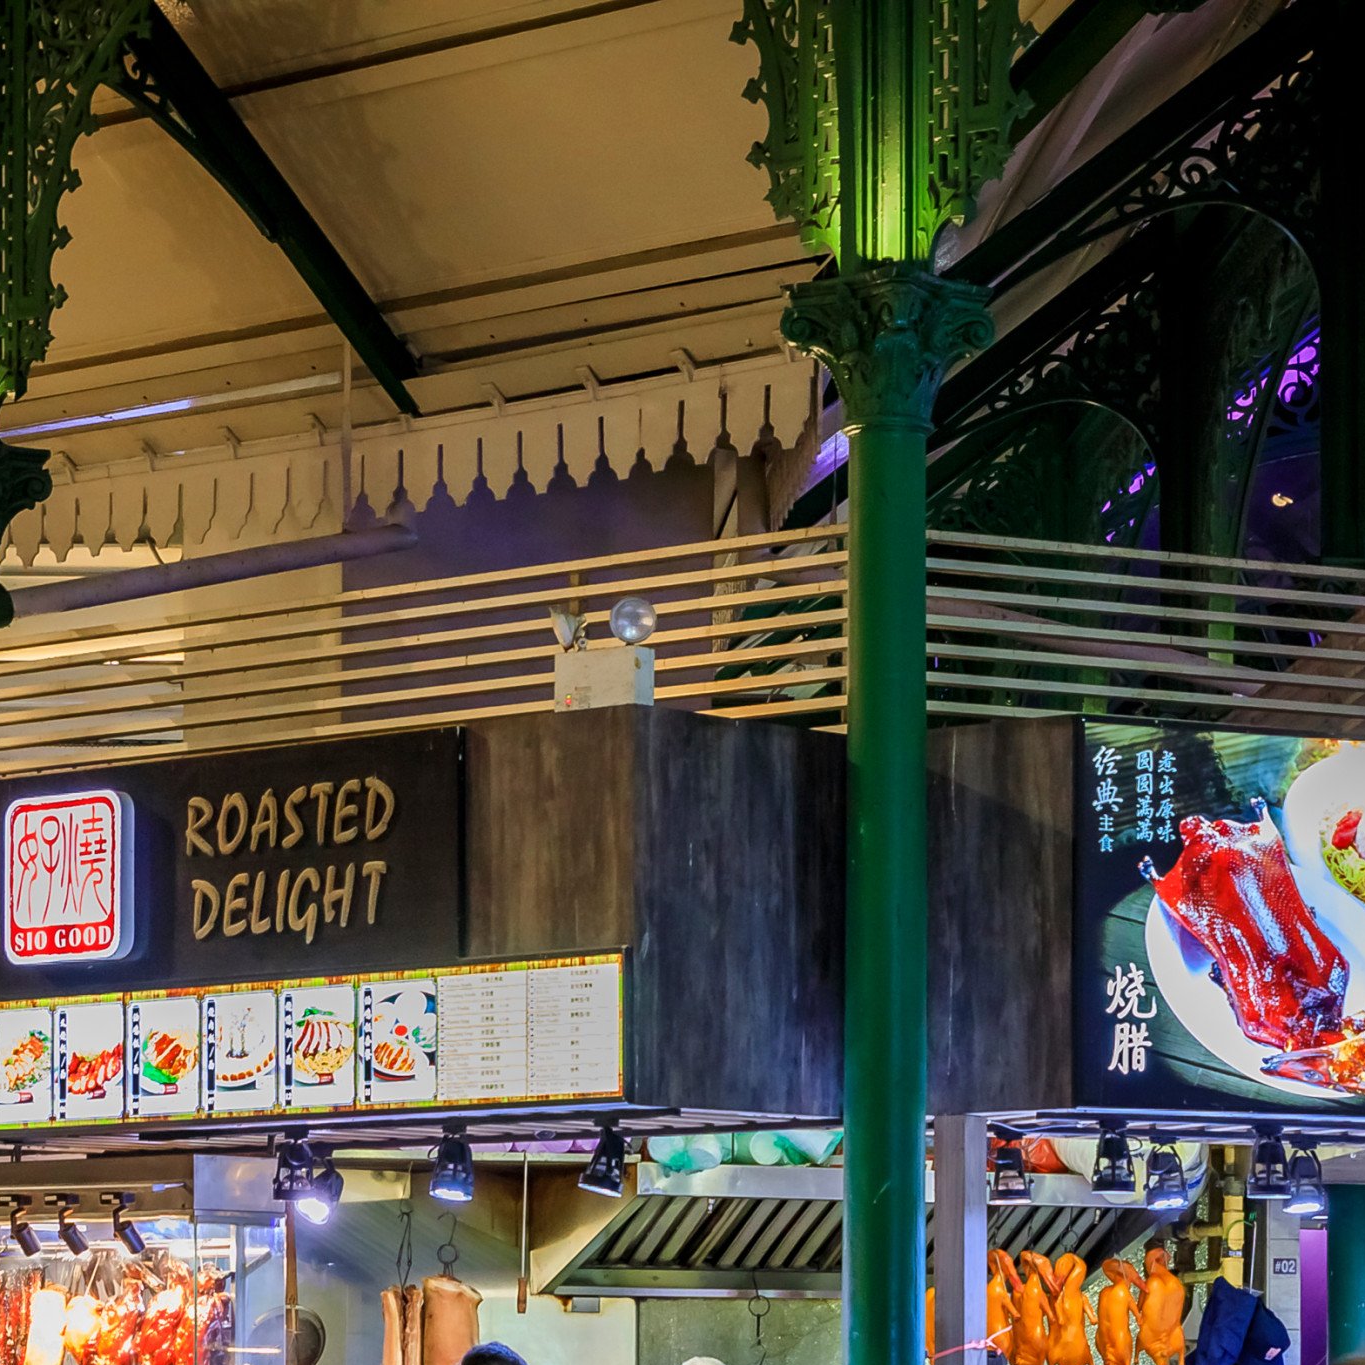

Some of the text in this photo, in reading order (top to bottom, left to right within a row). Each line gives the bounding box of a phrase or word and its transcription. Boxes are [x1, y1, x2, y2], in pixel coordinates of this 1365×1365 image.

[186, 776, 395, 857] ROASTED
[1092, 745, 1124, 852] 经典主食
[1155, 750, 1177, 843] 煮出原味
[14, 925, 112, 951] SIO GOOD
[191, 861, 387, 944] DELIGHT
[1105, 962, 1157, 1075] 烧腊
[1275, 1259, 1296, 1273] #02
